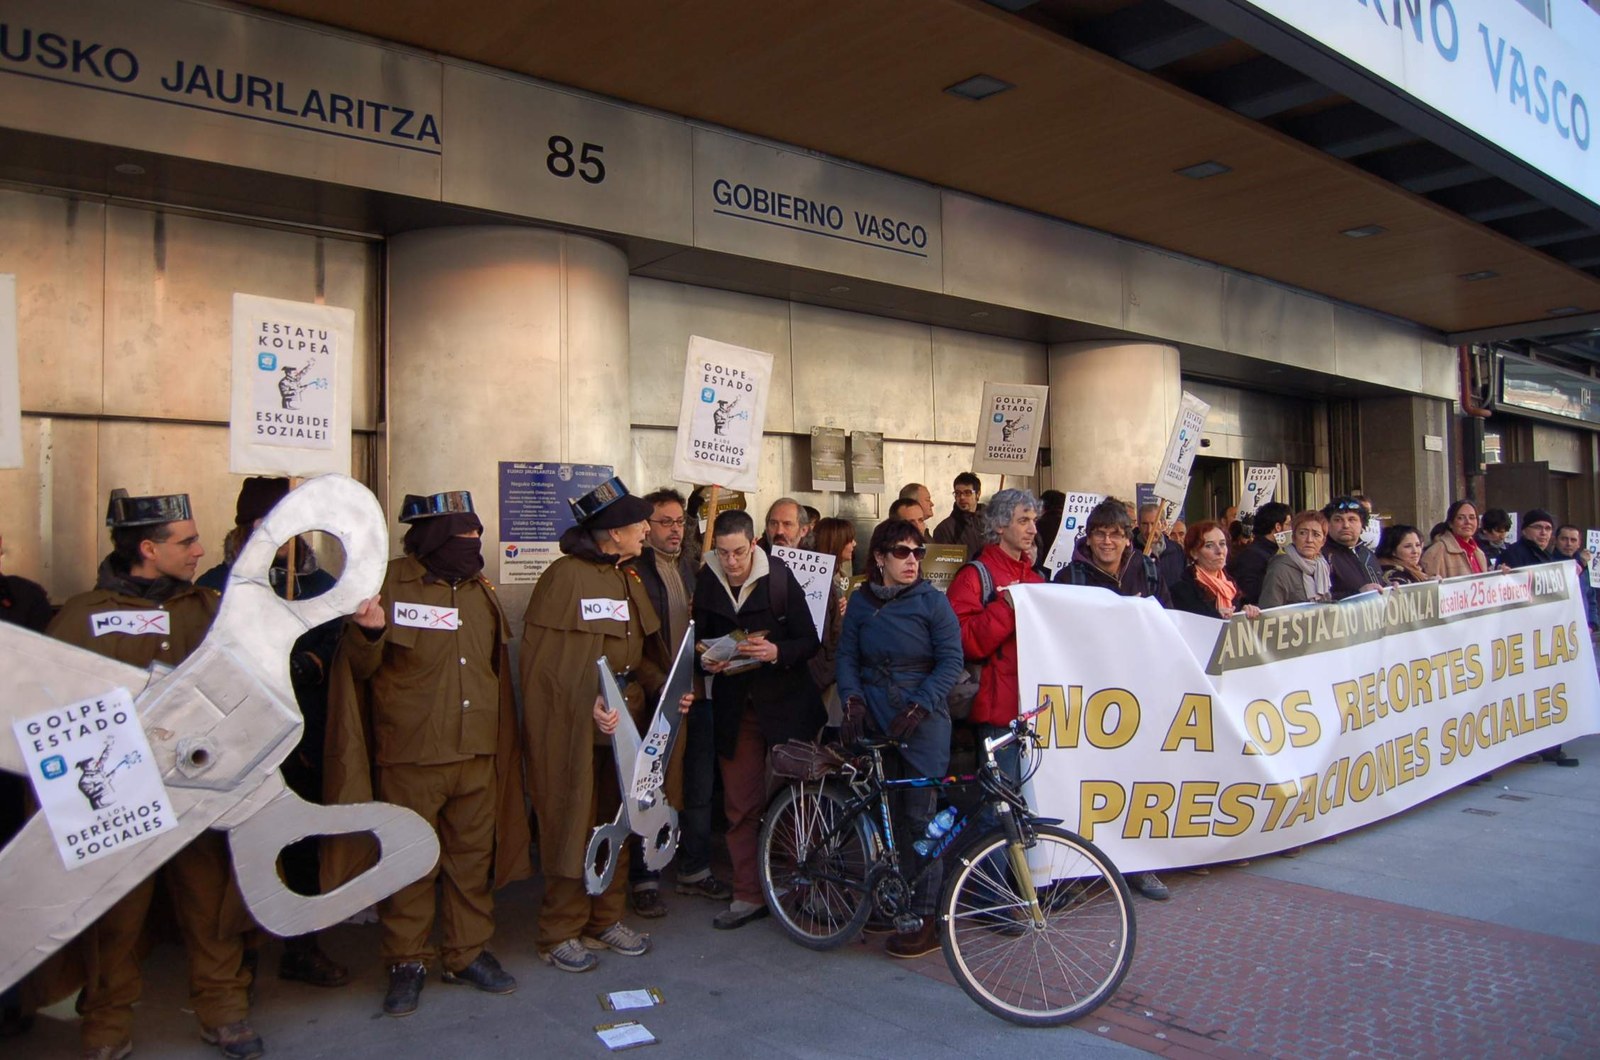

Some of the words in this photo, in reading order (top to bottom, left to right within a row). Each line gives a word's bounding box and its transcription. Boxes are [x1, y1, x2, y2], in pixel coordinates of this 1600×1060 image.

[1478, 22, 1590, 151] VASCO
[161, 60, 441, 145] JAURLARITZA
[546, 135, 606, 184] 85
[713, 179, 843, 231] GOBIERNO
[855, 211, 927, 249] VASCO
[262, 322, 328, 341] ESTATU
[258, 336, 329, 355] KOLPEA
[704, 362, 746, 380] GOLPE
[704, 374, 753, 393] ESTADO
[995, 404, 1033, 413] ESTADO
[996, 396, 1027, 405] GOLPE
[256, 411, 329, 428] ESKUBIDE
[257, 424, 326, 440] SOZIALEI
[693, 439, 744, 456] DERECHOS
[988, 445, 1027, 453] DERECHOS
[988, 452, 1024, 460] SOCIALES
[694, 450, 741, 466] SOCIALES
[1070, 495, 1097, 504] GOLPE
[778, 549, 820, 563] GOLPE
[784, 560, 827, 575] STADO
[1471, 581, 1486, 607] 25
[1487, 585, 1497, 604] de
[1535, 568, 1564, 596] BILBO
[397, 608, 419, 621] NO
[584, 603, 602, 614] NO
[96, 615, 122, 630] NO
[1034, 684, 1141, 750] NO
[1161, 692, 1215, 752] A
[1332, 643, 1484, 735] RECORTES
[1490, 633, 1524, 682] DE
[1533, 621, 1579, 670] LAS
[27, 699, 107, 737] GOLPE
[33, 711, 128, 753] ESTADO
[1078, 726, 1431, 841] PRESTACIONES
[1440, 682, 1568, 766] SOCIALES
[66, 800, 162, 847] DERECHOS
[76, 816, 163, 860] SOCIALES
